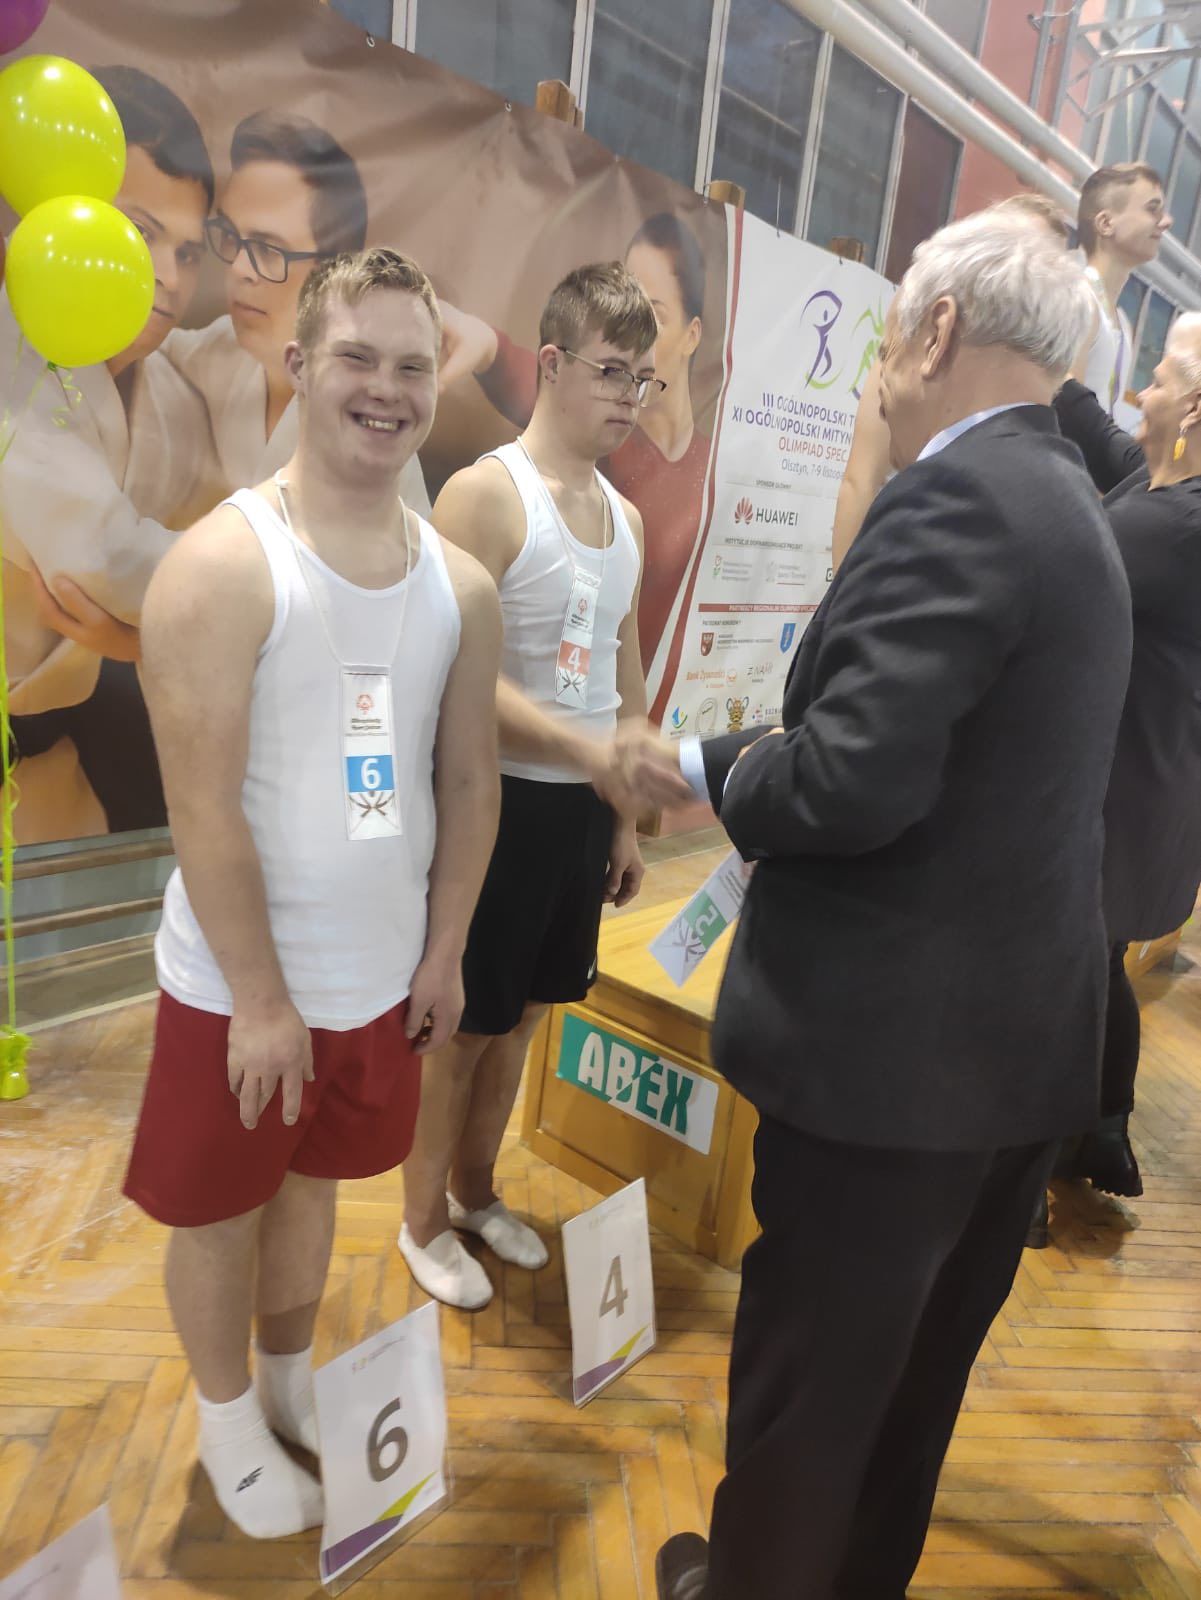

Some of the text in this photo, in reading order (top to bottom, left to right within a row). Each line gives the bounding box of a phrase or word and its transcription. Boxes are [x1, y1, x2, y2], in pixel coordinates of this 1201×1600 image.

[732, 405, 742, 422] XI
[745, 408, 820, 439] OGÓLNOPOLSKI
[762, 392, 774, 408] III
[777, 394, 846, 425] OGÓLNOPOLSKI
[778, 436, 848, 463] OLIMPIAD SPEC
[755, 508, 799, 526] HUAWEI
[567, 647, 581, 671] 4
[360, 757, 382, 790] 6
[577, 1031, 694, 1136] ABEX
[599, 1255, 629, 1318] 4
[366, 1397, 408, 1483] 6
